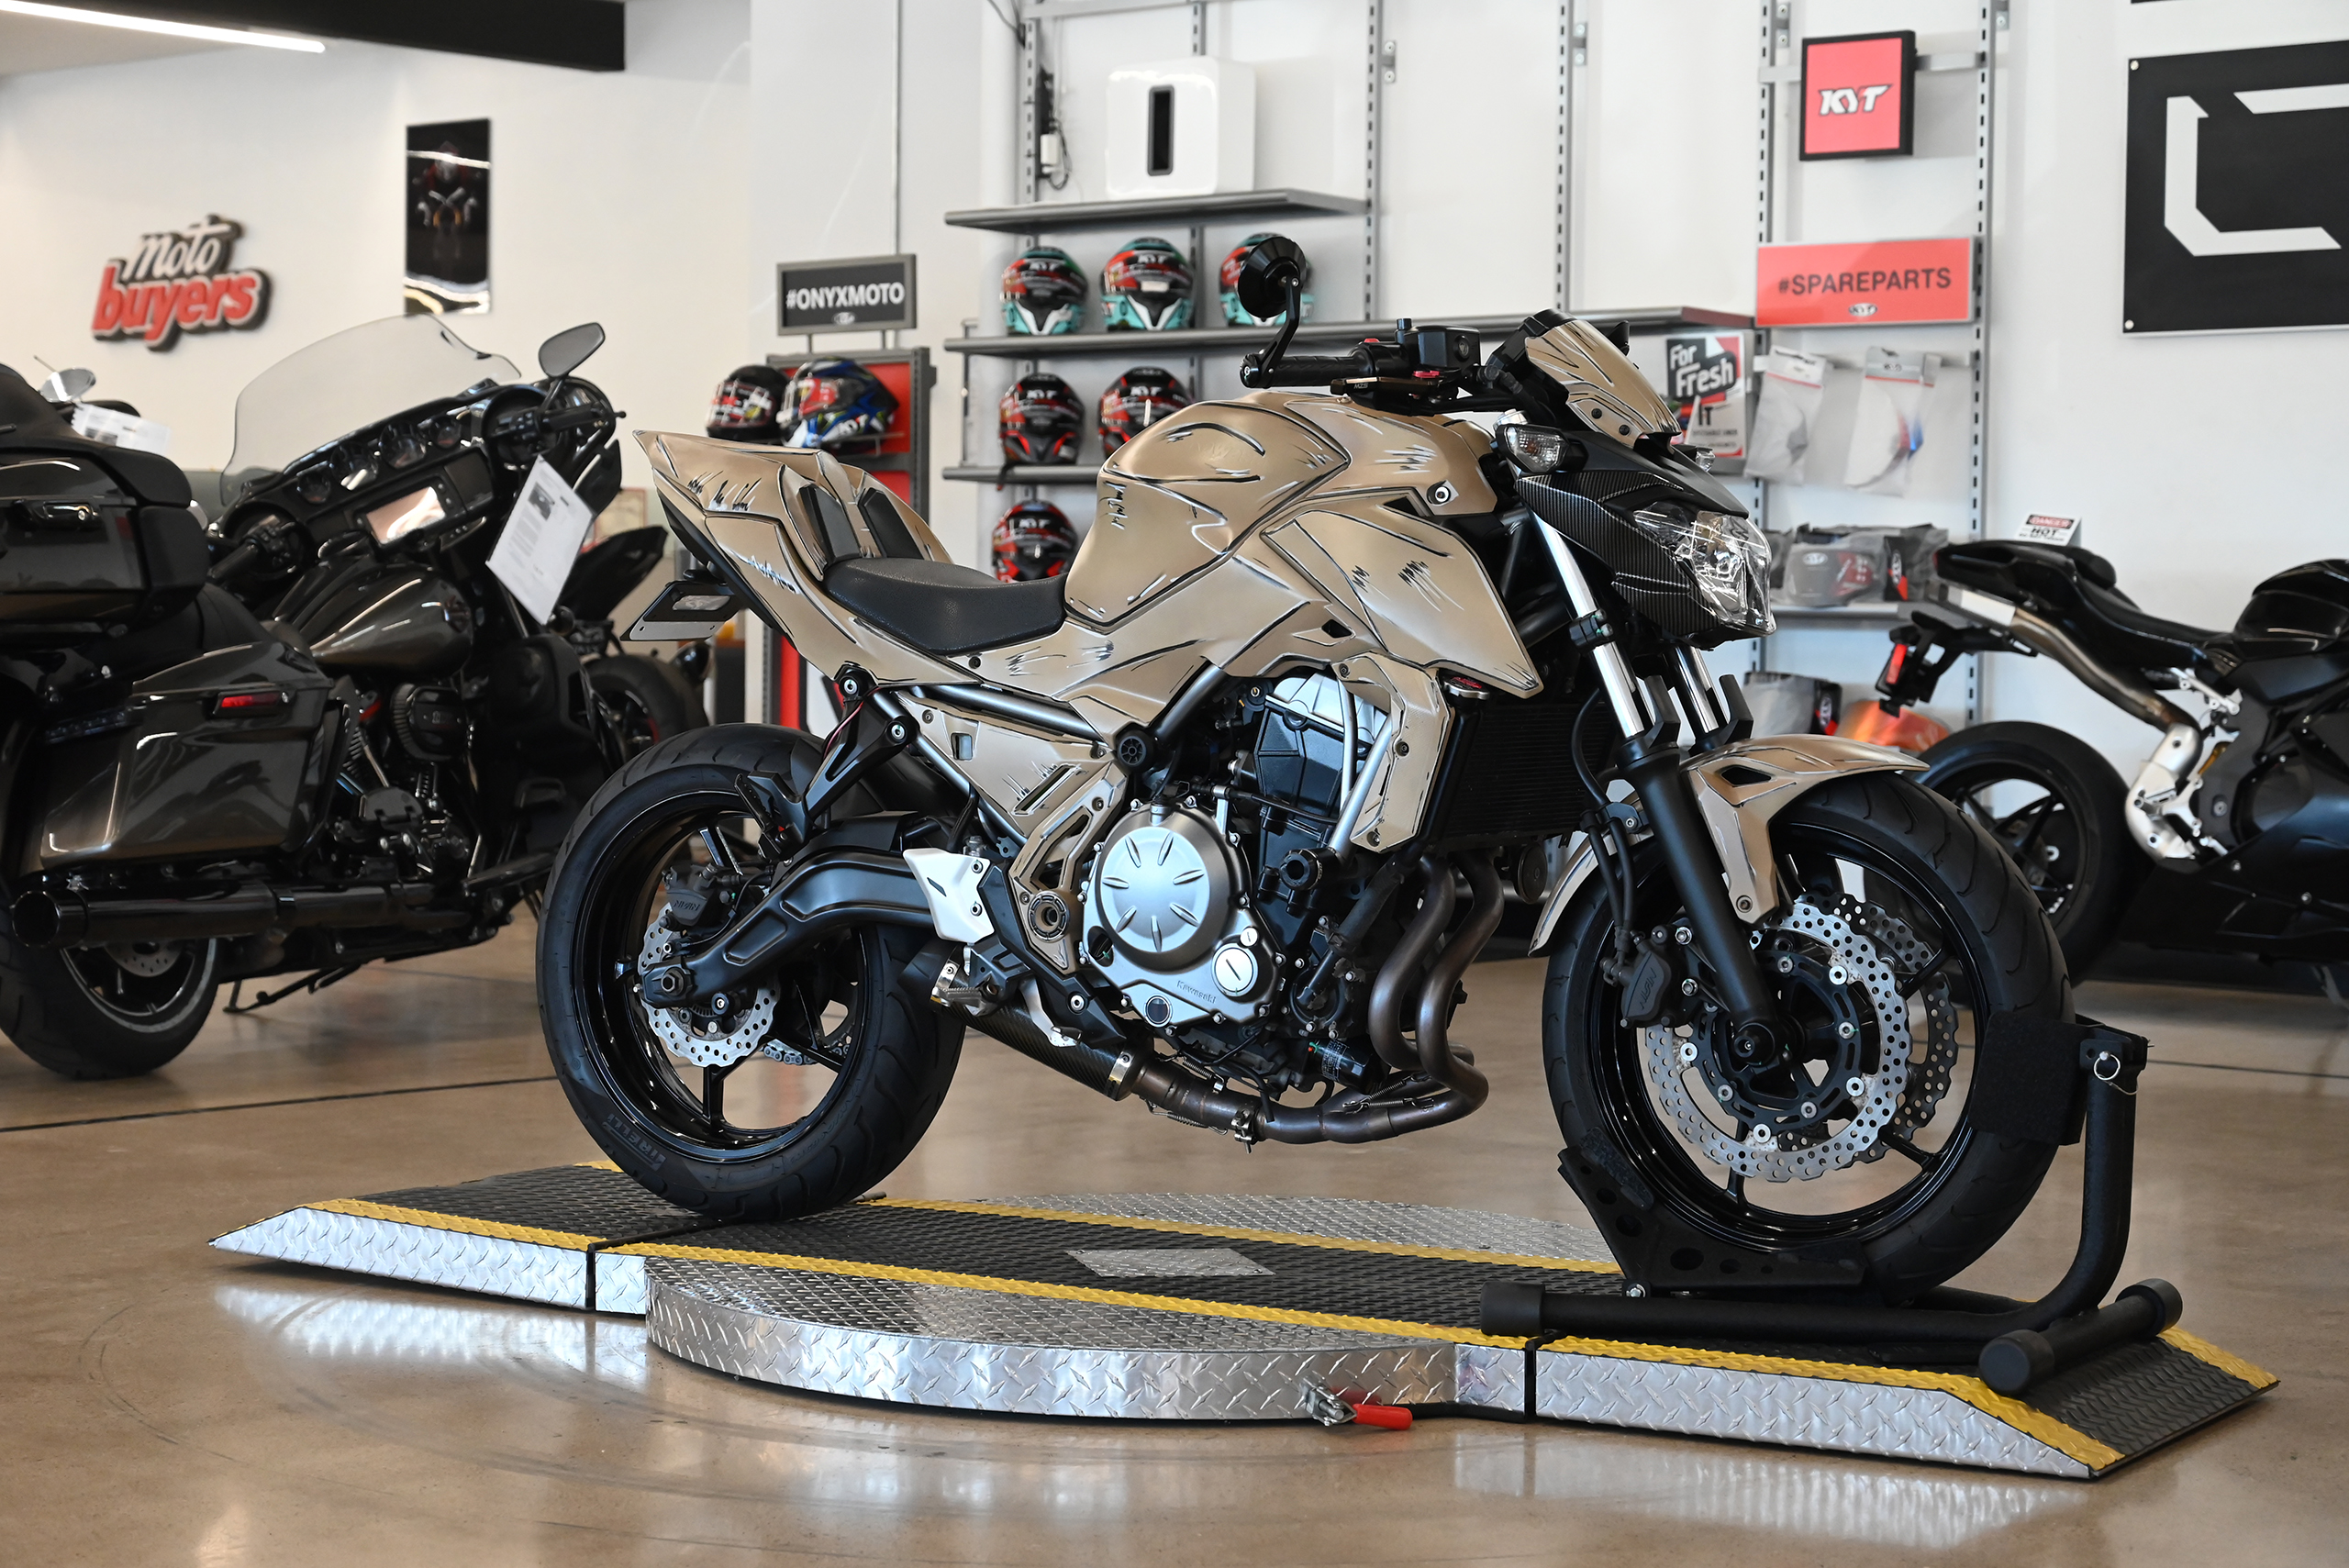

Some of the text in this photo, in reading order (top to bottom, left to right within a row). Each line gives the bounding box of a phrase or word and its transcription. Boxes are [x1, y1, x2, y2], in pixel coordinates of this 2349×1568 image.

[1818, 83, 1893, 117] KYT
[786, 282, 906, 310] #ONYXMOTO
[1778, 267, 1952, 295] #SPAREPARTS
[91, 261, 260, 345] buyers
[1670, 343, 1698, 370] For
[1675, 357, 1734, 398] Fresh
[1176, 980, 1217, 1005] Kawasaki
[603, 1113, 666, 1172] PIRELLI
